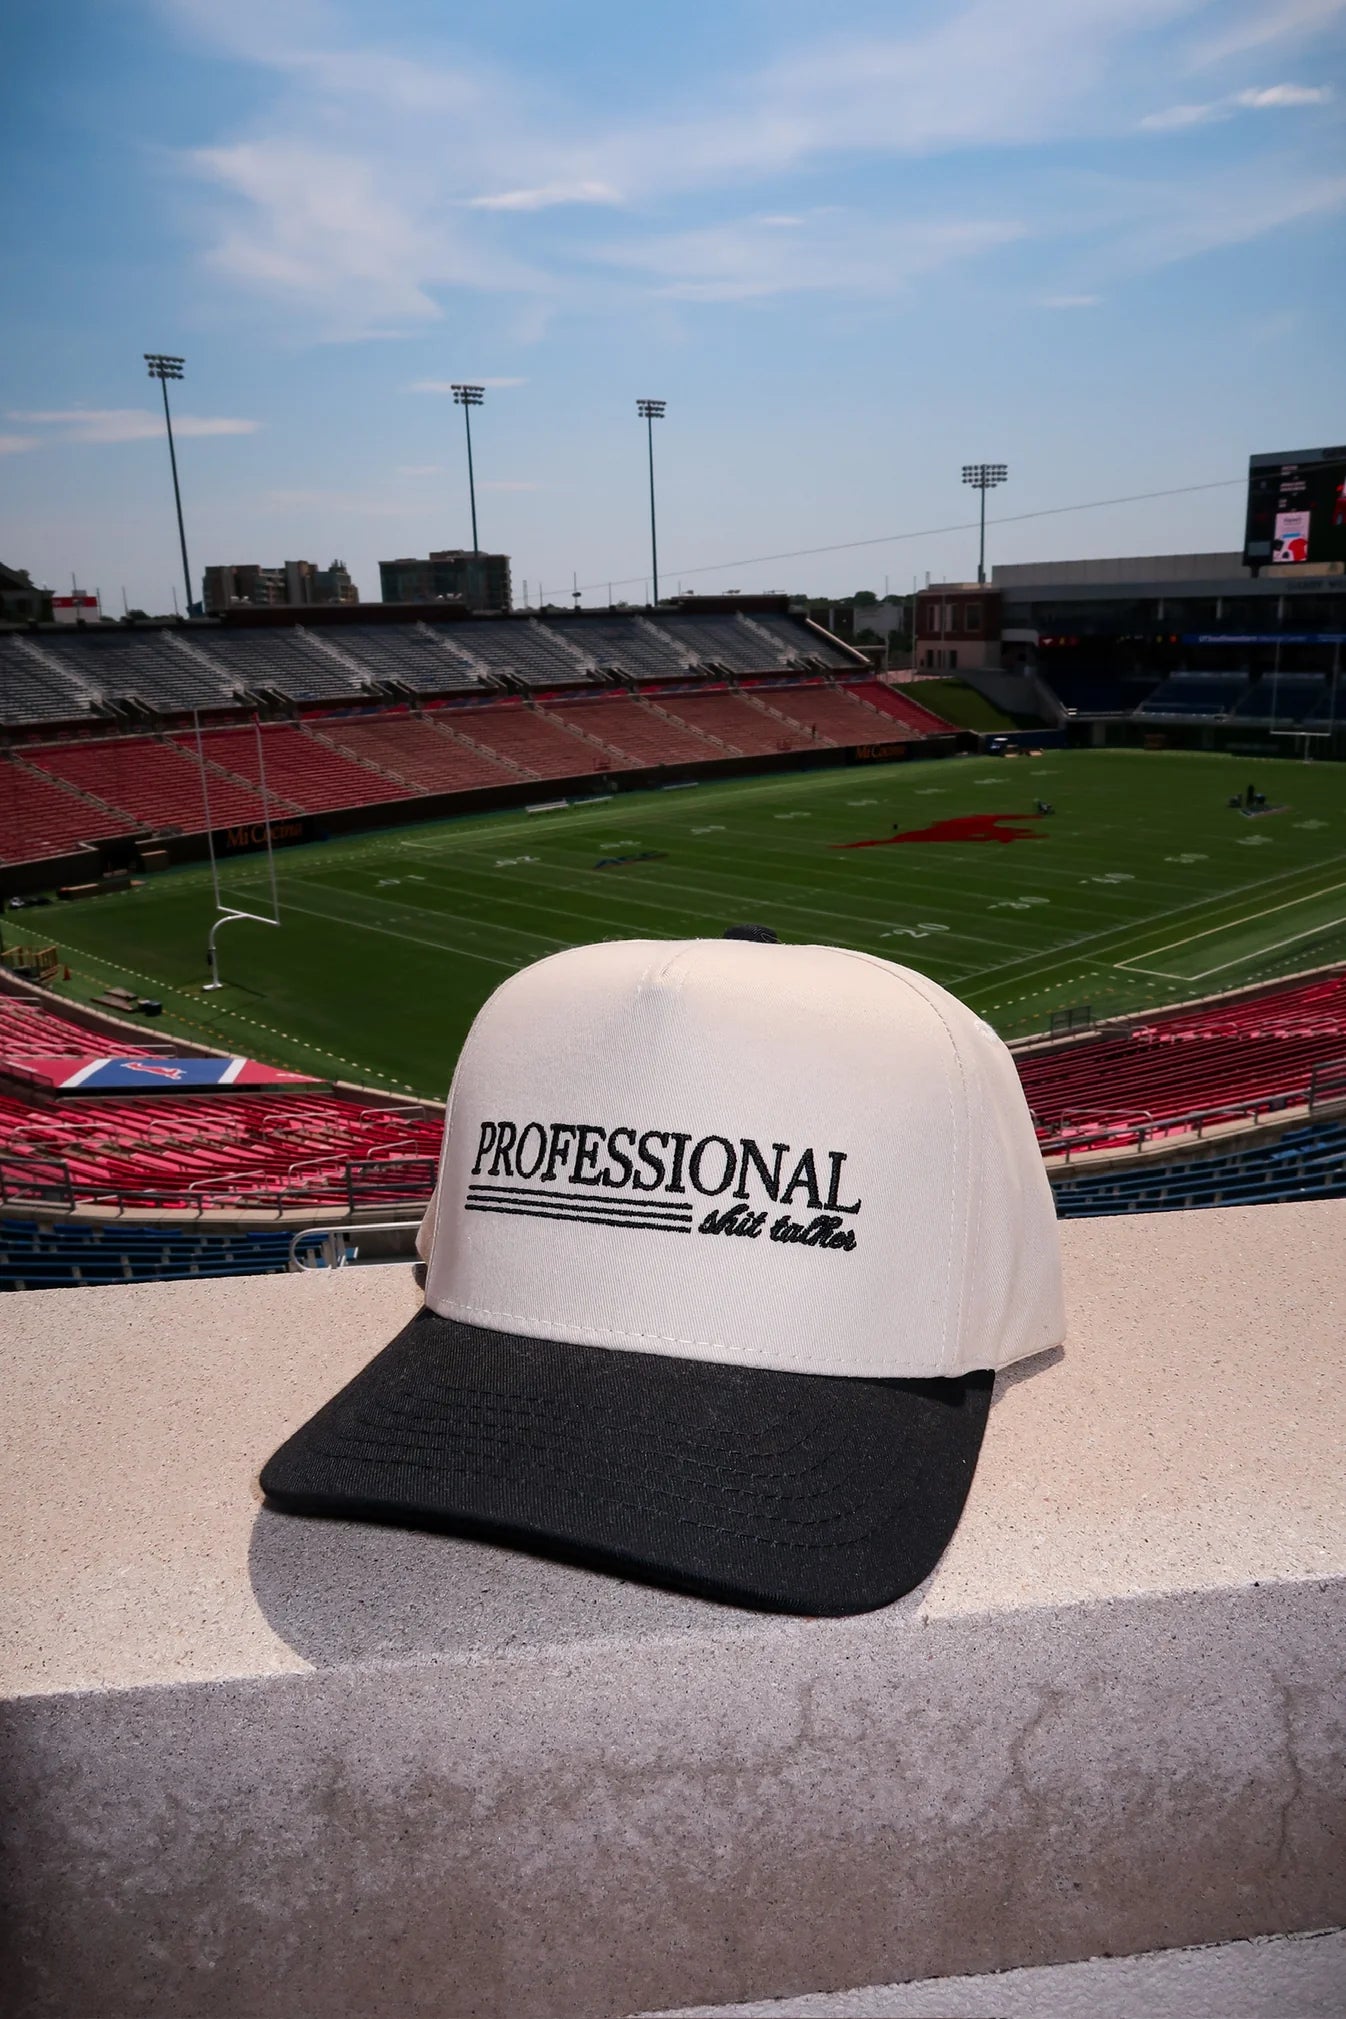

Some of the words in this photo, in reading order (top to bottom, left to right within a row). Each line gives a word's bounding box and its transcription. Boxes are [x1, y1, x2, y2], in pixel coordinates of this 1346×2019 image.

[471, 1120, 861, 1215] PROFESSIONAL
[698, 1203, 768, 1238] shit
[770, 1210, 857, 1251] talker
